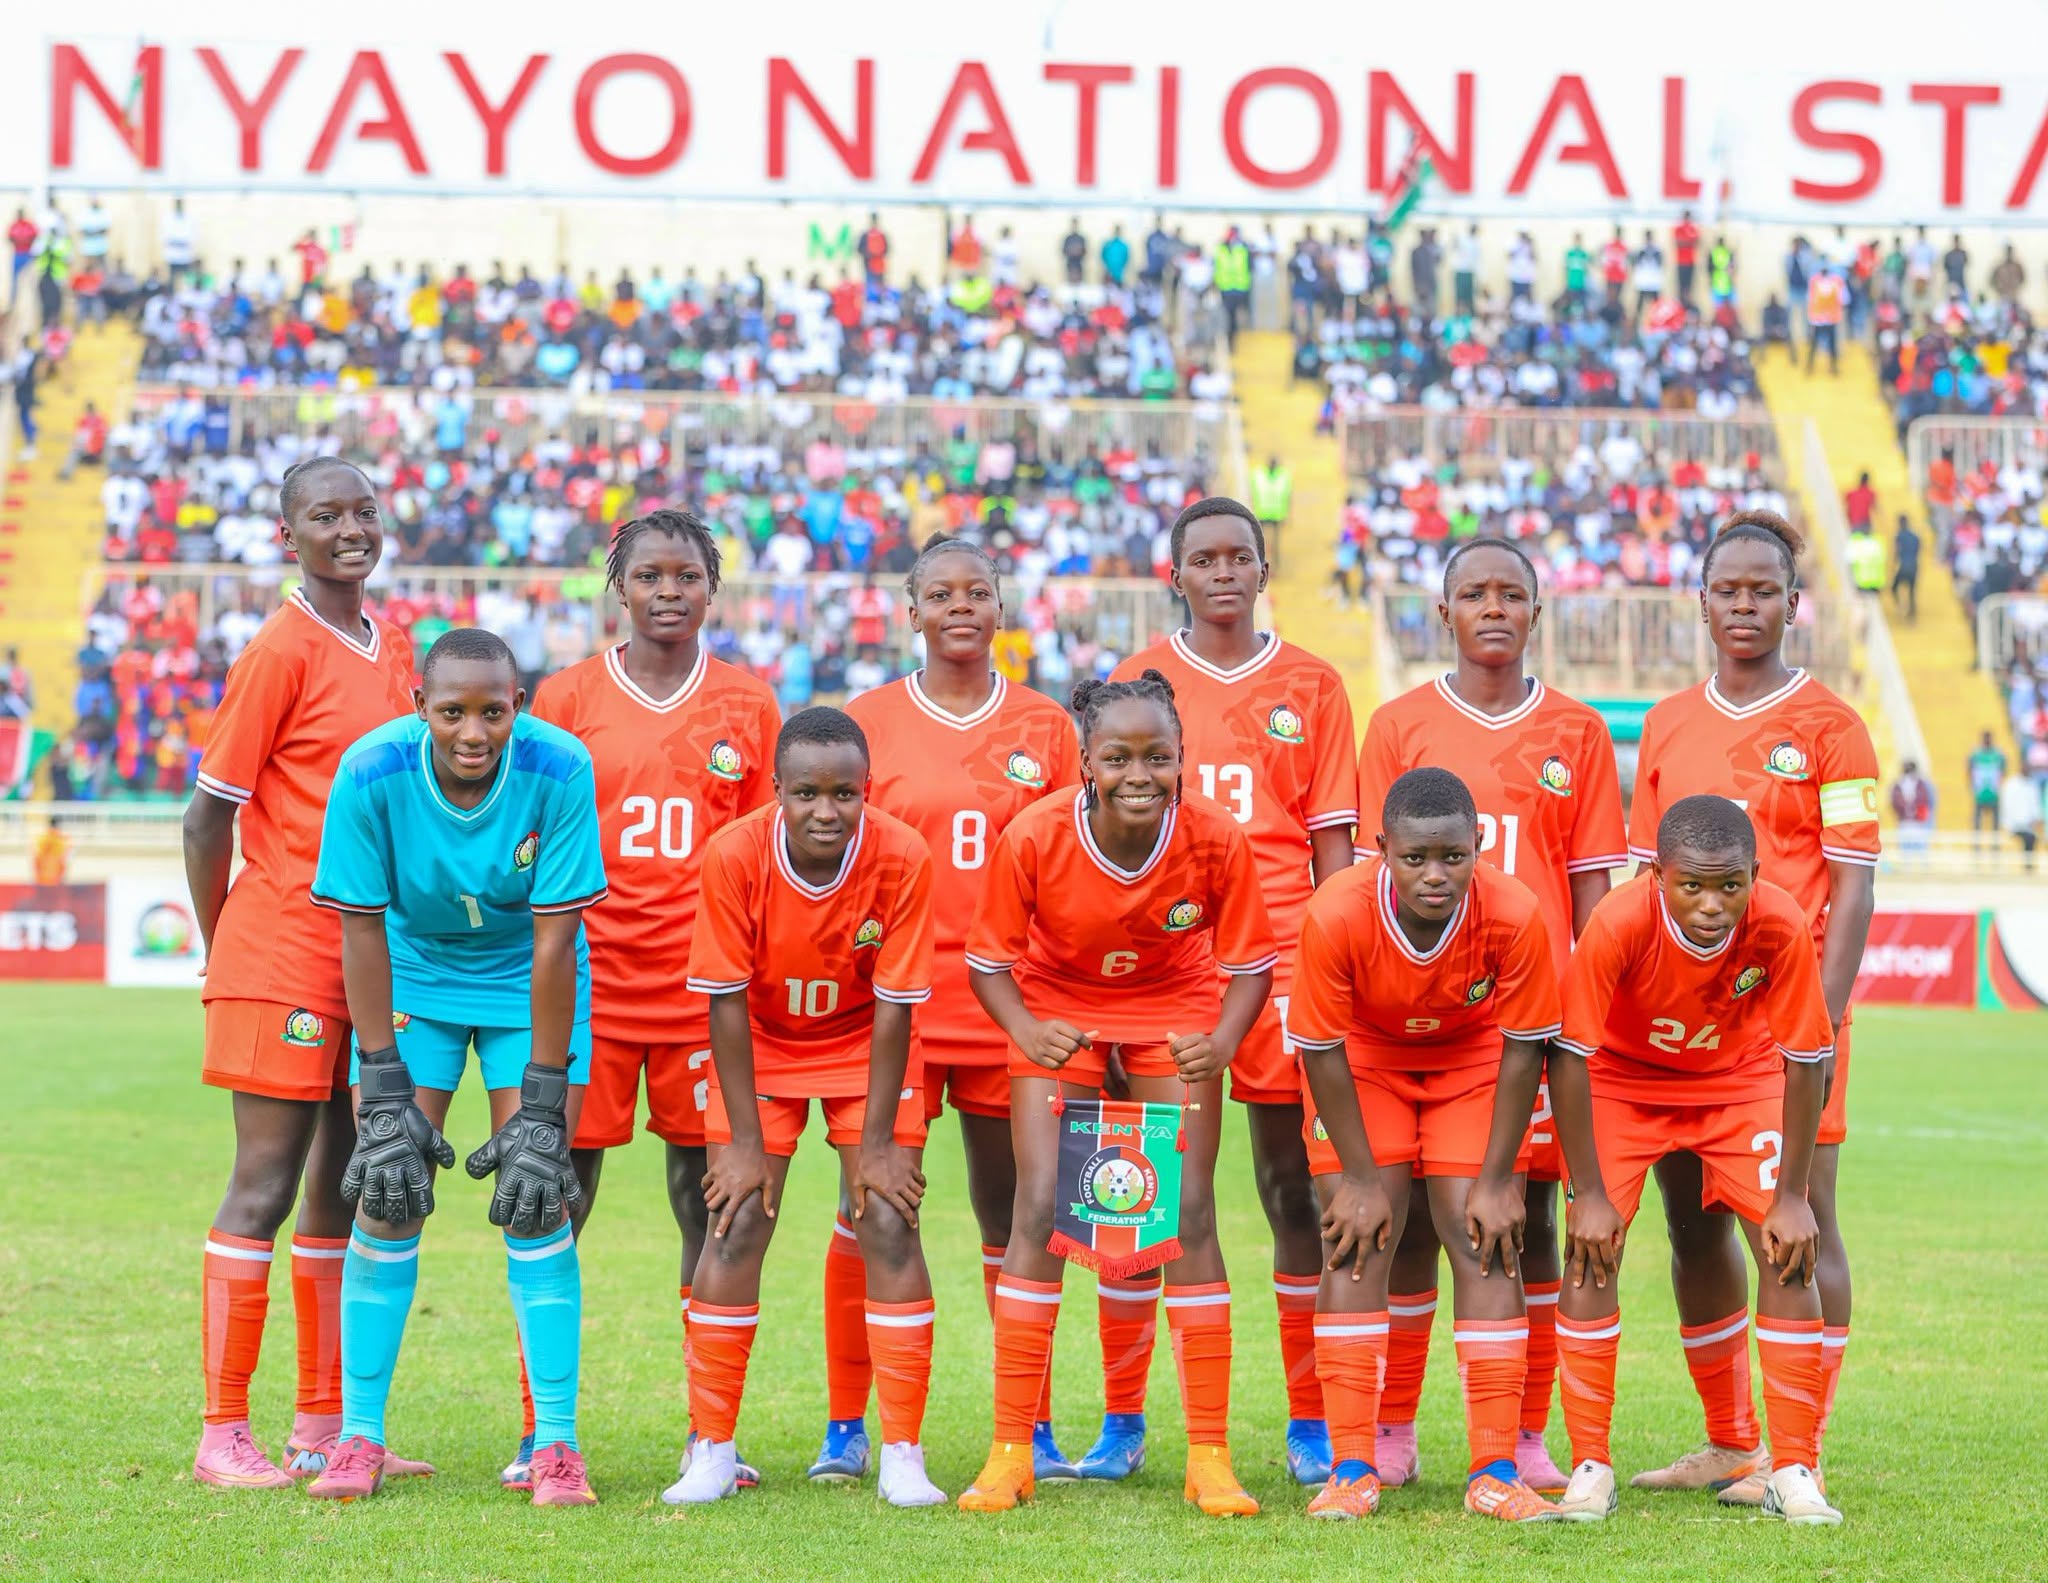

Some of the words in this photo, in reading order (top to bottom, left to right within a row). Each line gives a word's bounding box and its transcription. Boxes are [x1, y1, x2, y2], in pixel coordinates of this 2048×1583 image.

[51, 44, 693, 176] NYAYO
[766, 57, 1732, 199] NATIONAL
[1198, 763, 1254, 824] 13
[619, 795, 694, 859] 20
[951, 809, 987, 870] 8
[460, 894, 483, 928] 1
[1101, 950, 1139, 977] 6
[785, 977, 839, 1018] 10
[1405, 1018, 1441, 1033] 9
[1648, 1017, 1721, 1054] 24
[1070, 1121, 1173, 1139] KENYA
[1083, 1156, 1104, 1205] FOOTBALL
[1143, 1167, 1155, 1202] KENYA
[1087, 1212, 1147, 1225] FEDERATION
